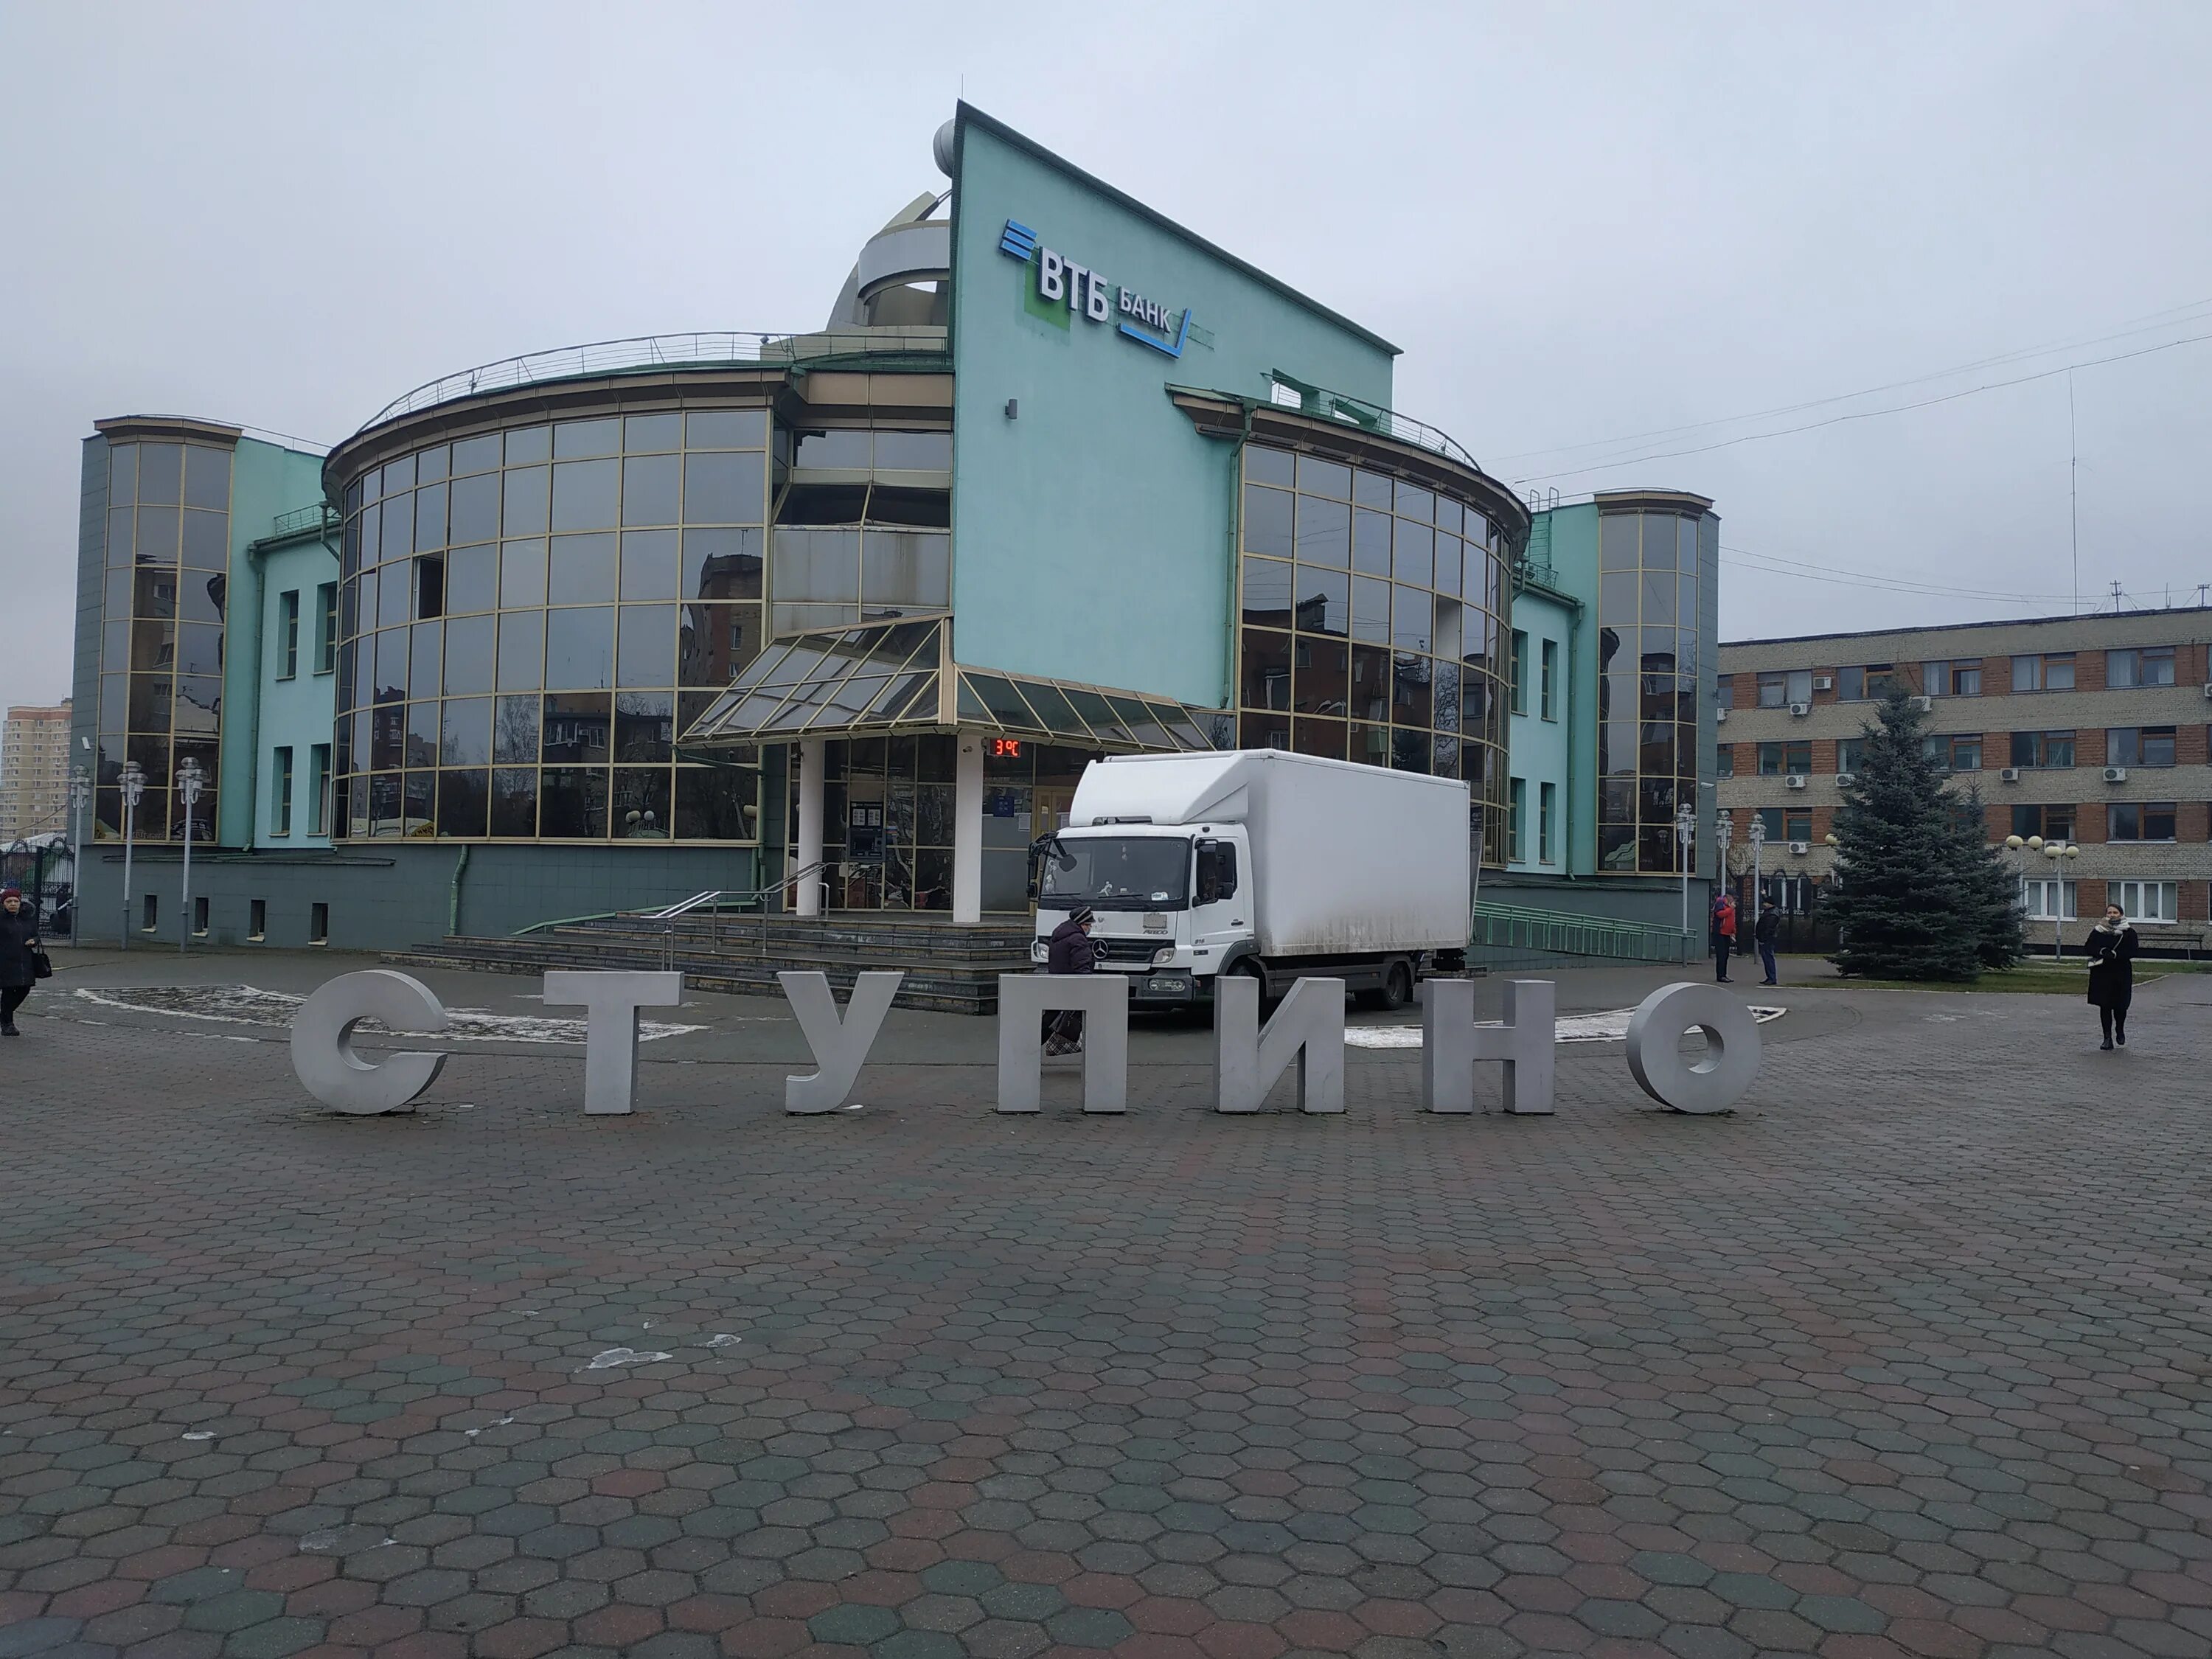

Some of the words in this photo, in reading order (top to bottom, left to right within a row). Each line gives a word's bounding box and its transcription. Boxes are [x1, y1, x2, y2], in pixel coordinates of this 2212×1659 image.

[1040, 246, 1109, 322] ВТБ
[1119, 287, 1171, 333] БАНК
[291, 970, 1762, 1114] СТУПИНО
